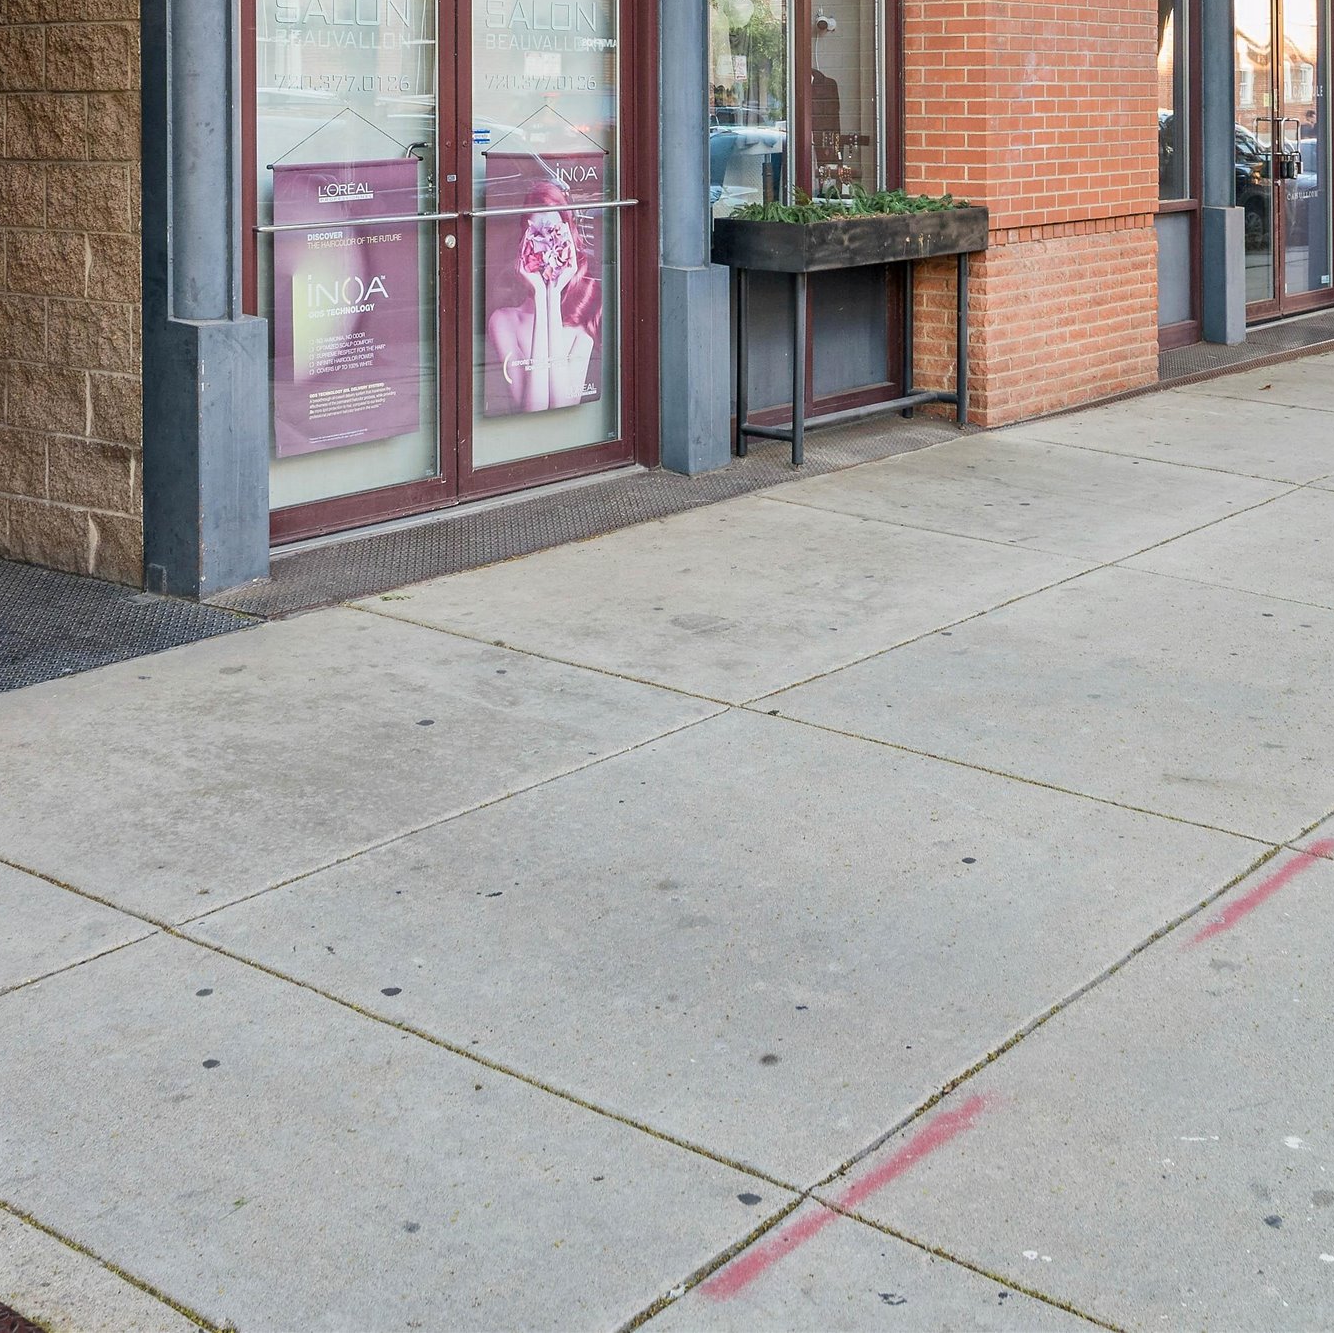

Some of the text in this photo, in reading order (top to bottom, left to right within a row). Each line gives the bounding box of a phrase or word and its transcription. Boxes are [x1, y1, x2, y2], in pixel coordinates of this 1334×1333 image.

[275, 29, 412, 49] BEAUVALLON
[274, 73, 410, 92] 720.377.0126
[307, 231, 343, 242] DISCOVER
[307, 241, 320, 250] THE
[357, 236, 365, 245] OF
[367, 235, 378, 244] THE
[379, 233, 402, 243] FUTURE
[327, 303, 375, 316] TECHNOLOGY
